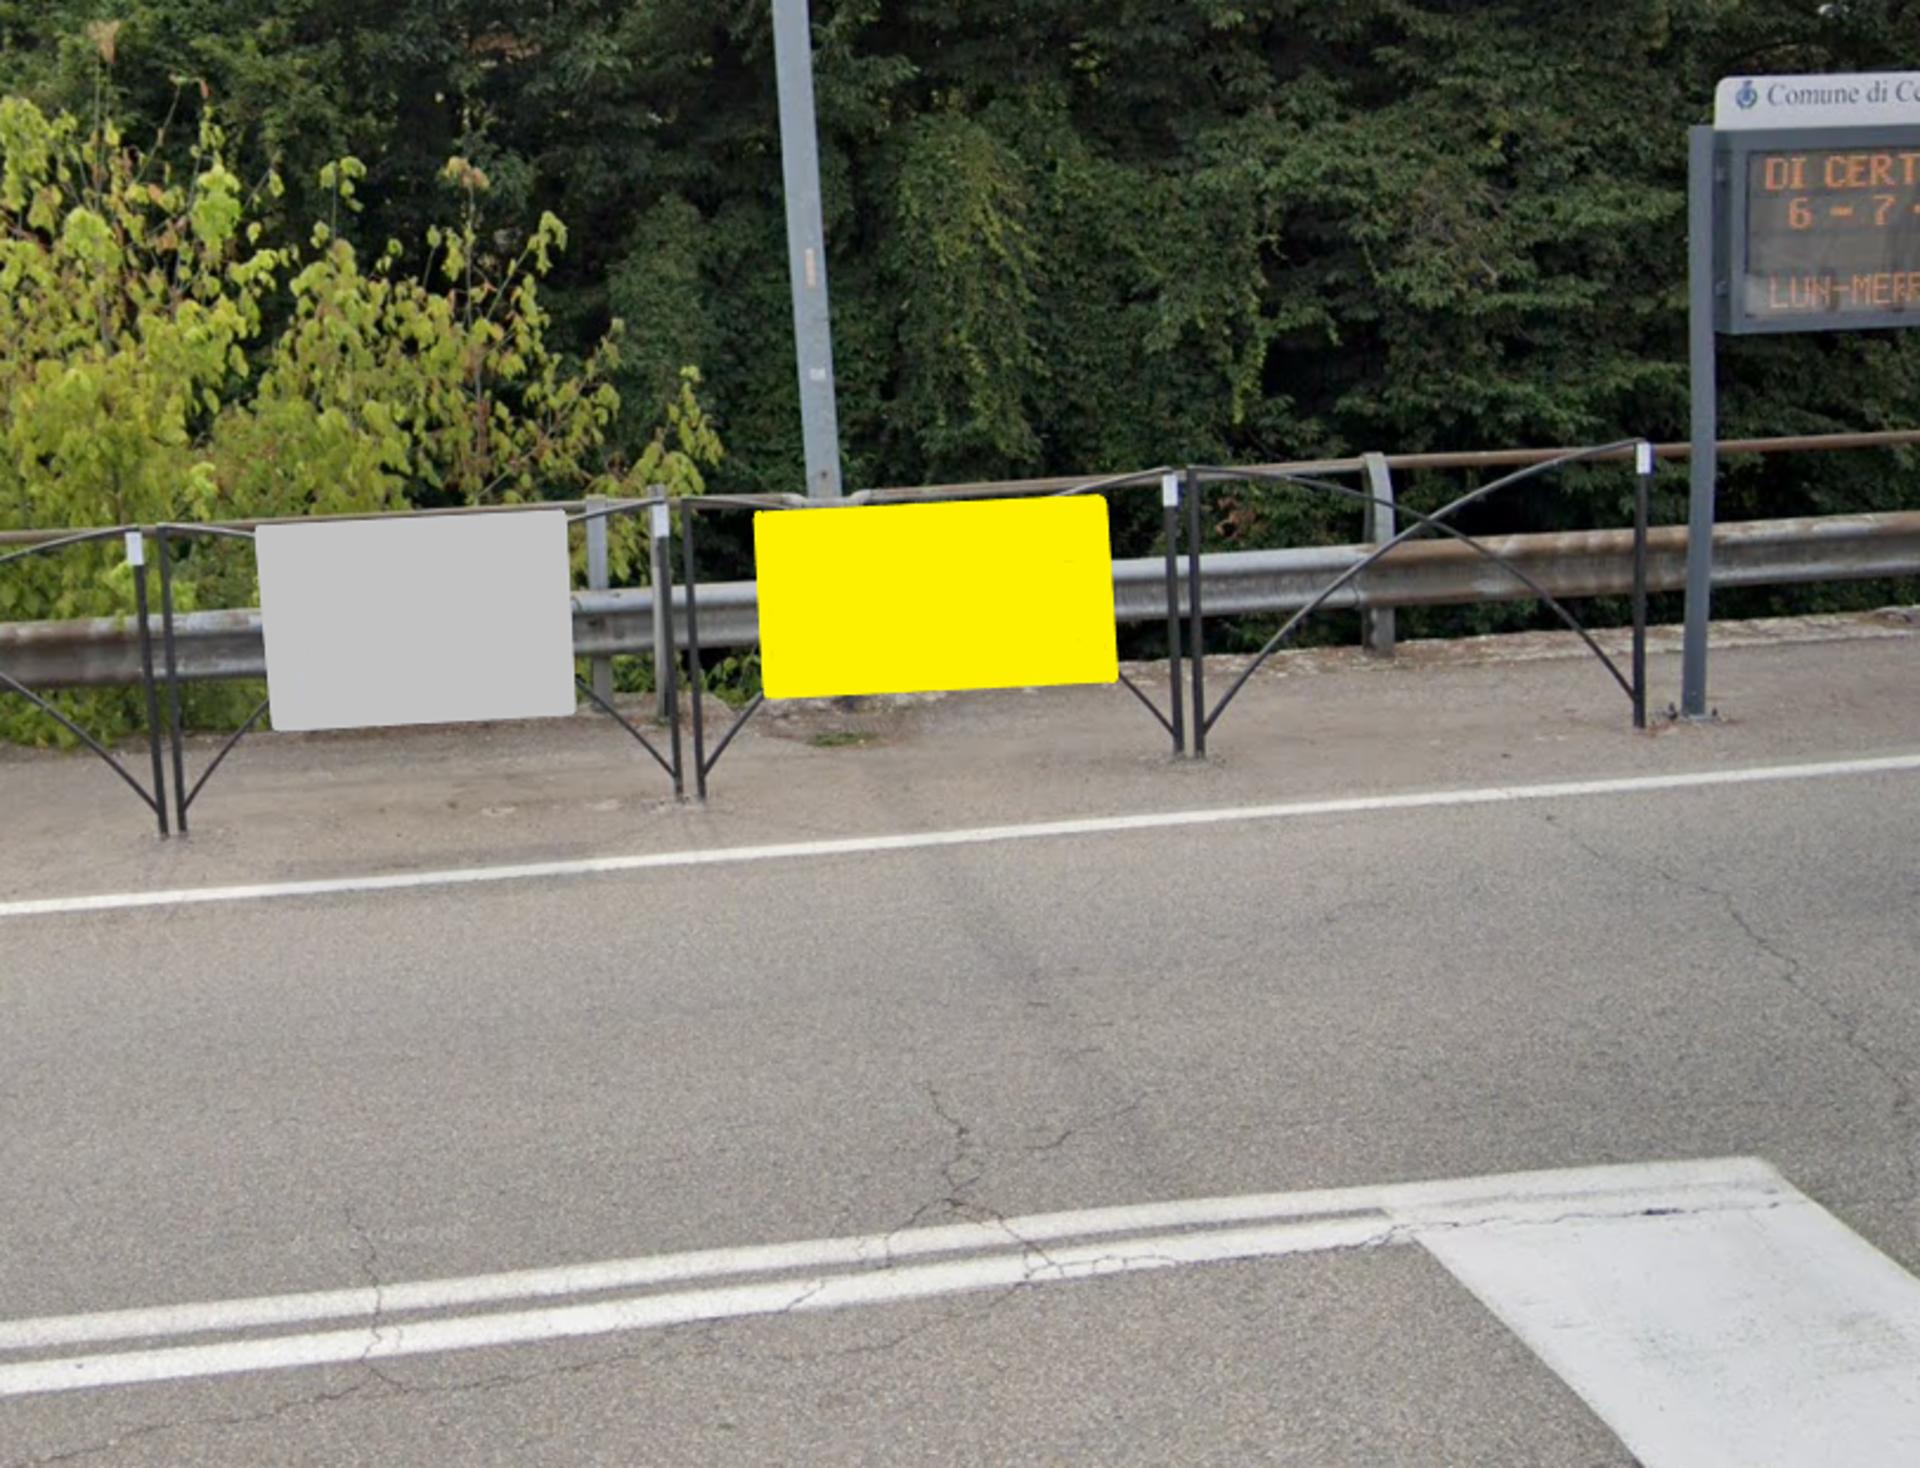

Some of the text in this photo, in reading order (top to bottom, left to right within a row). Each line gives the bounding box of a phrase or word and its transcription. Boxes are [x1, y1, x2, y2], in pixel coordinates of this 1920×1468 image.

[1767, 82, 1859, 106] Comune
[1866, 80, 1888, 103] di
[1765, 153, 1920, 191] DI CERT
[1789, 193, 1896, 230] 6 - 7
